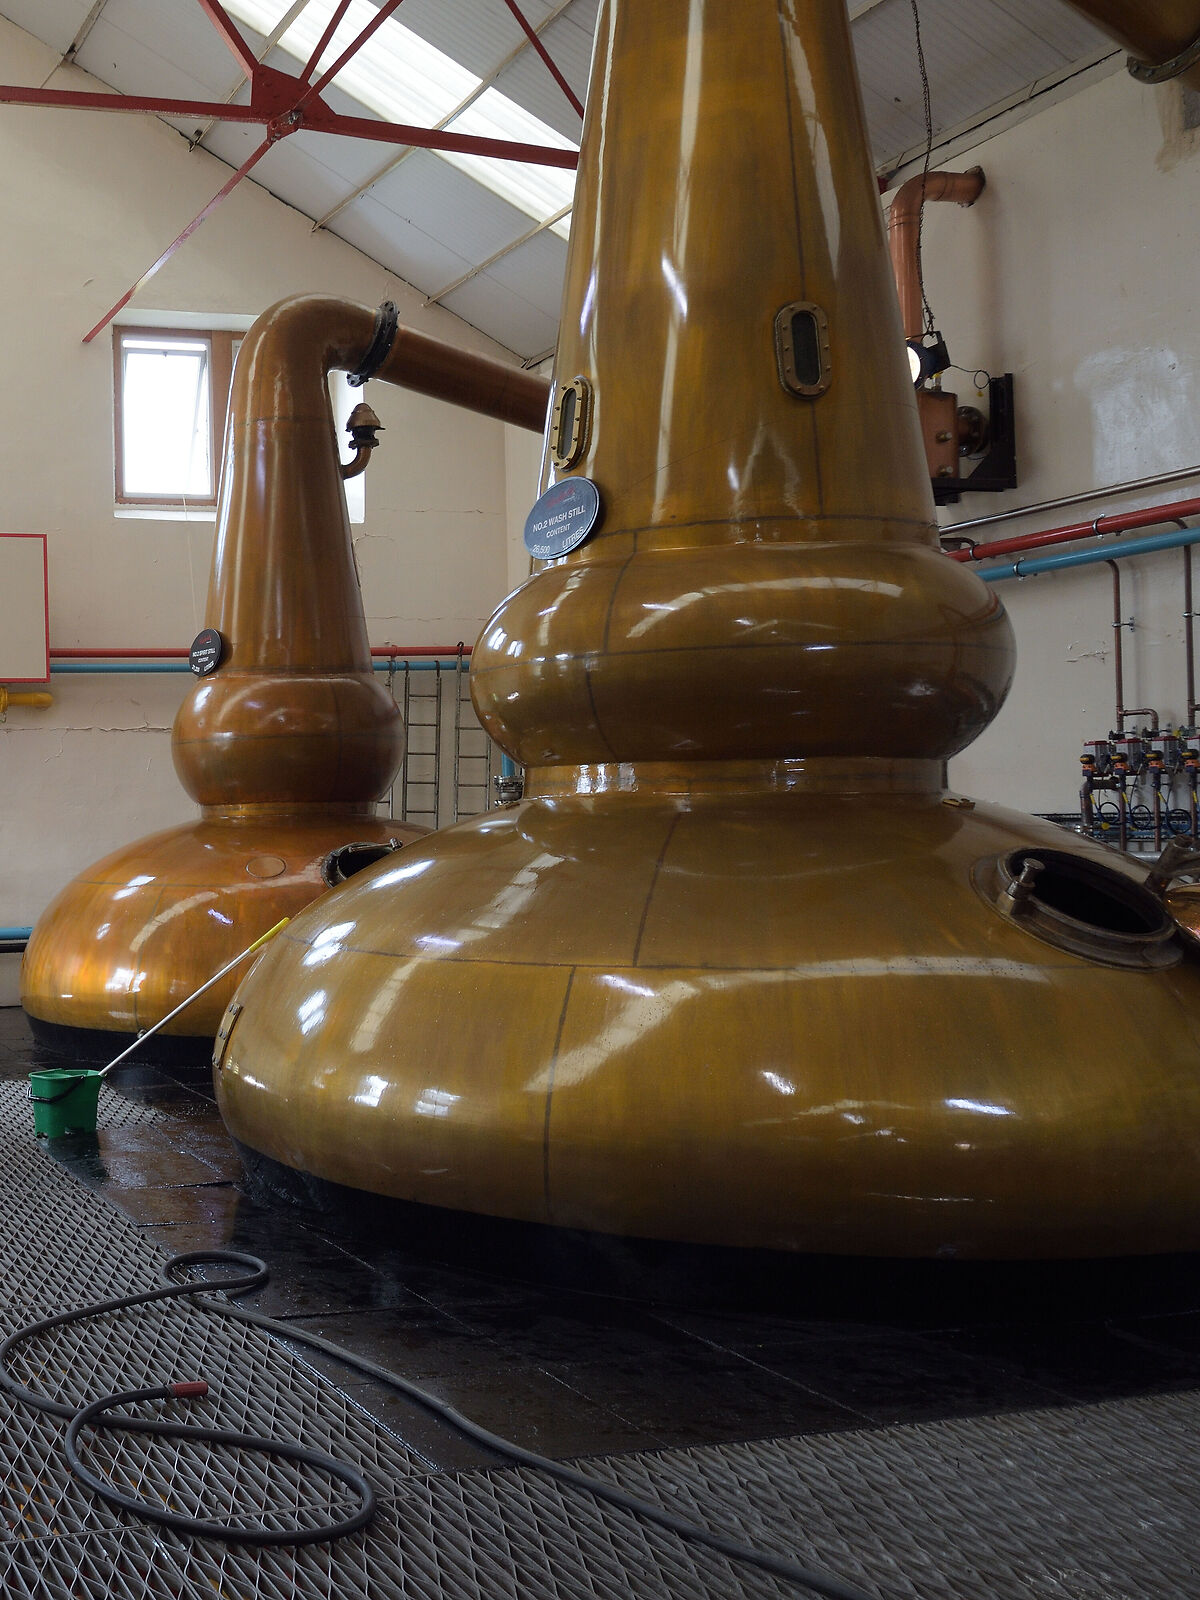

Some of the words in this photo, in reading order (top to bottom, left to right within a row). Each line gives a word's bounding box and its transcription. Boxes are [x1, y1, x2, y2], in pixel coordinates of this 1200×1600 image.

[532, 520, 548, 533] NO.2
[548, 512, 567, 527] WASH
[568, 505, 586, 518] STILL
[546, 523, 571, 538] CONTENT
[562, 526, 584, 548] LITRES
